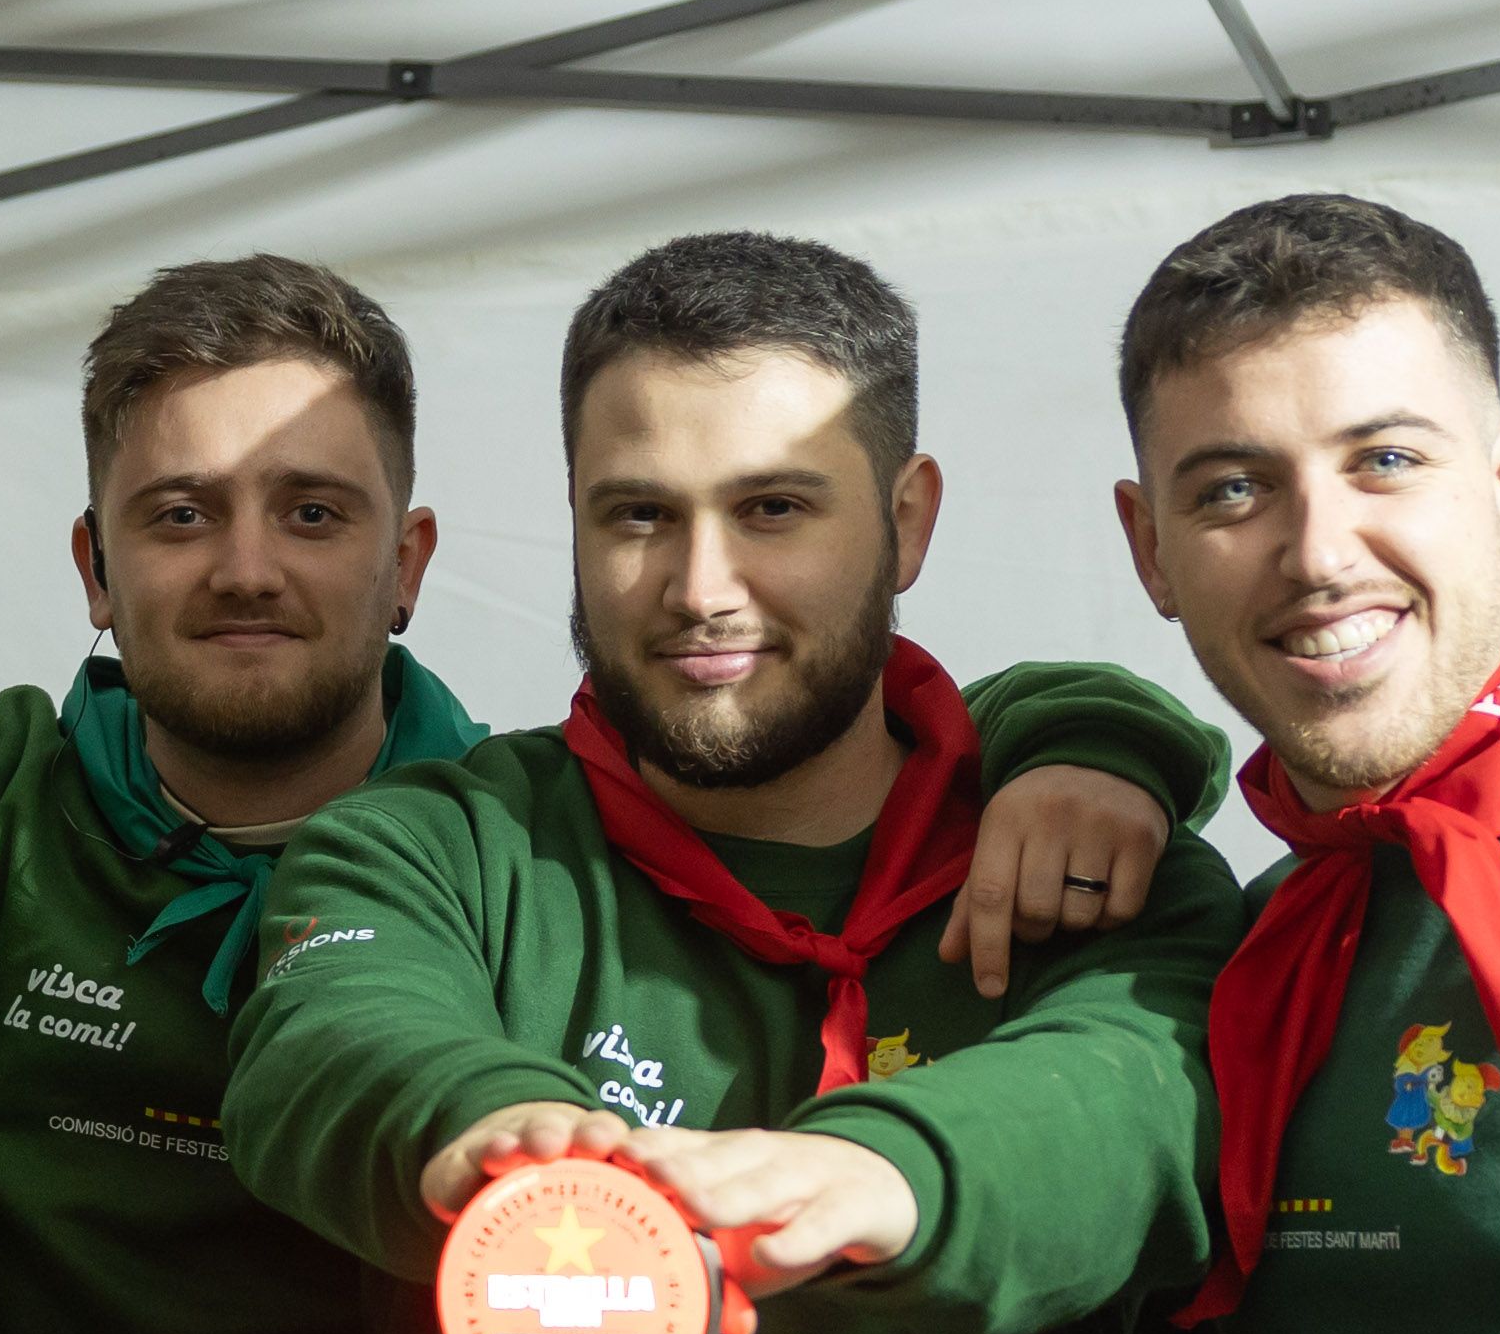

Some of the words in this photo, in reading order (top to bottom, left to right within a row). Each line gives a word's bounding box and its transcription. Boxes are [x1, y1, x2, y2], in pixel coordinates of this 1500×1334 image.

[27, 963, 125, 1011] visca
[3, 994, 32, 1030] la
[38, 1015, 137, 1052] comi!
[582, 1024, 664, 1088] visa
[48, 1115, 135, 1143] COMISSIÓ
[138, 1131, 161, 1150] DE
[165, 1136, 230, 1162] FESTES
[1281, 1231, 1323, 1249] FESTES
[1325, 1231, 1357, 1250] SANT
